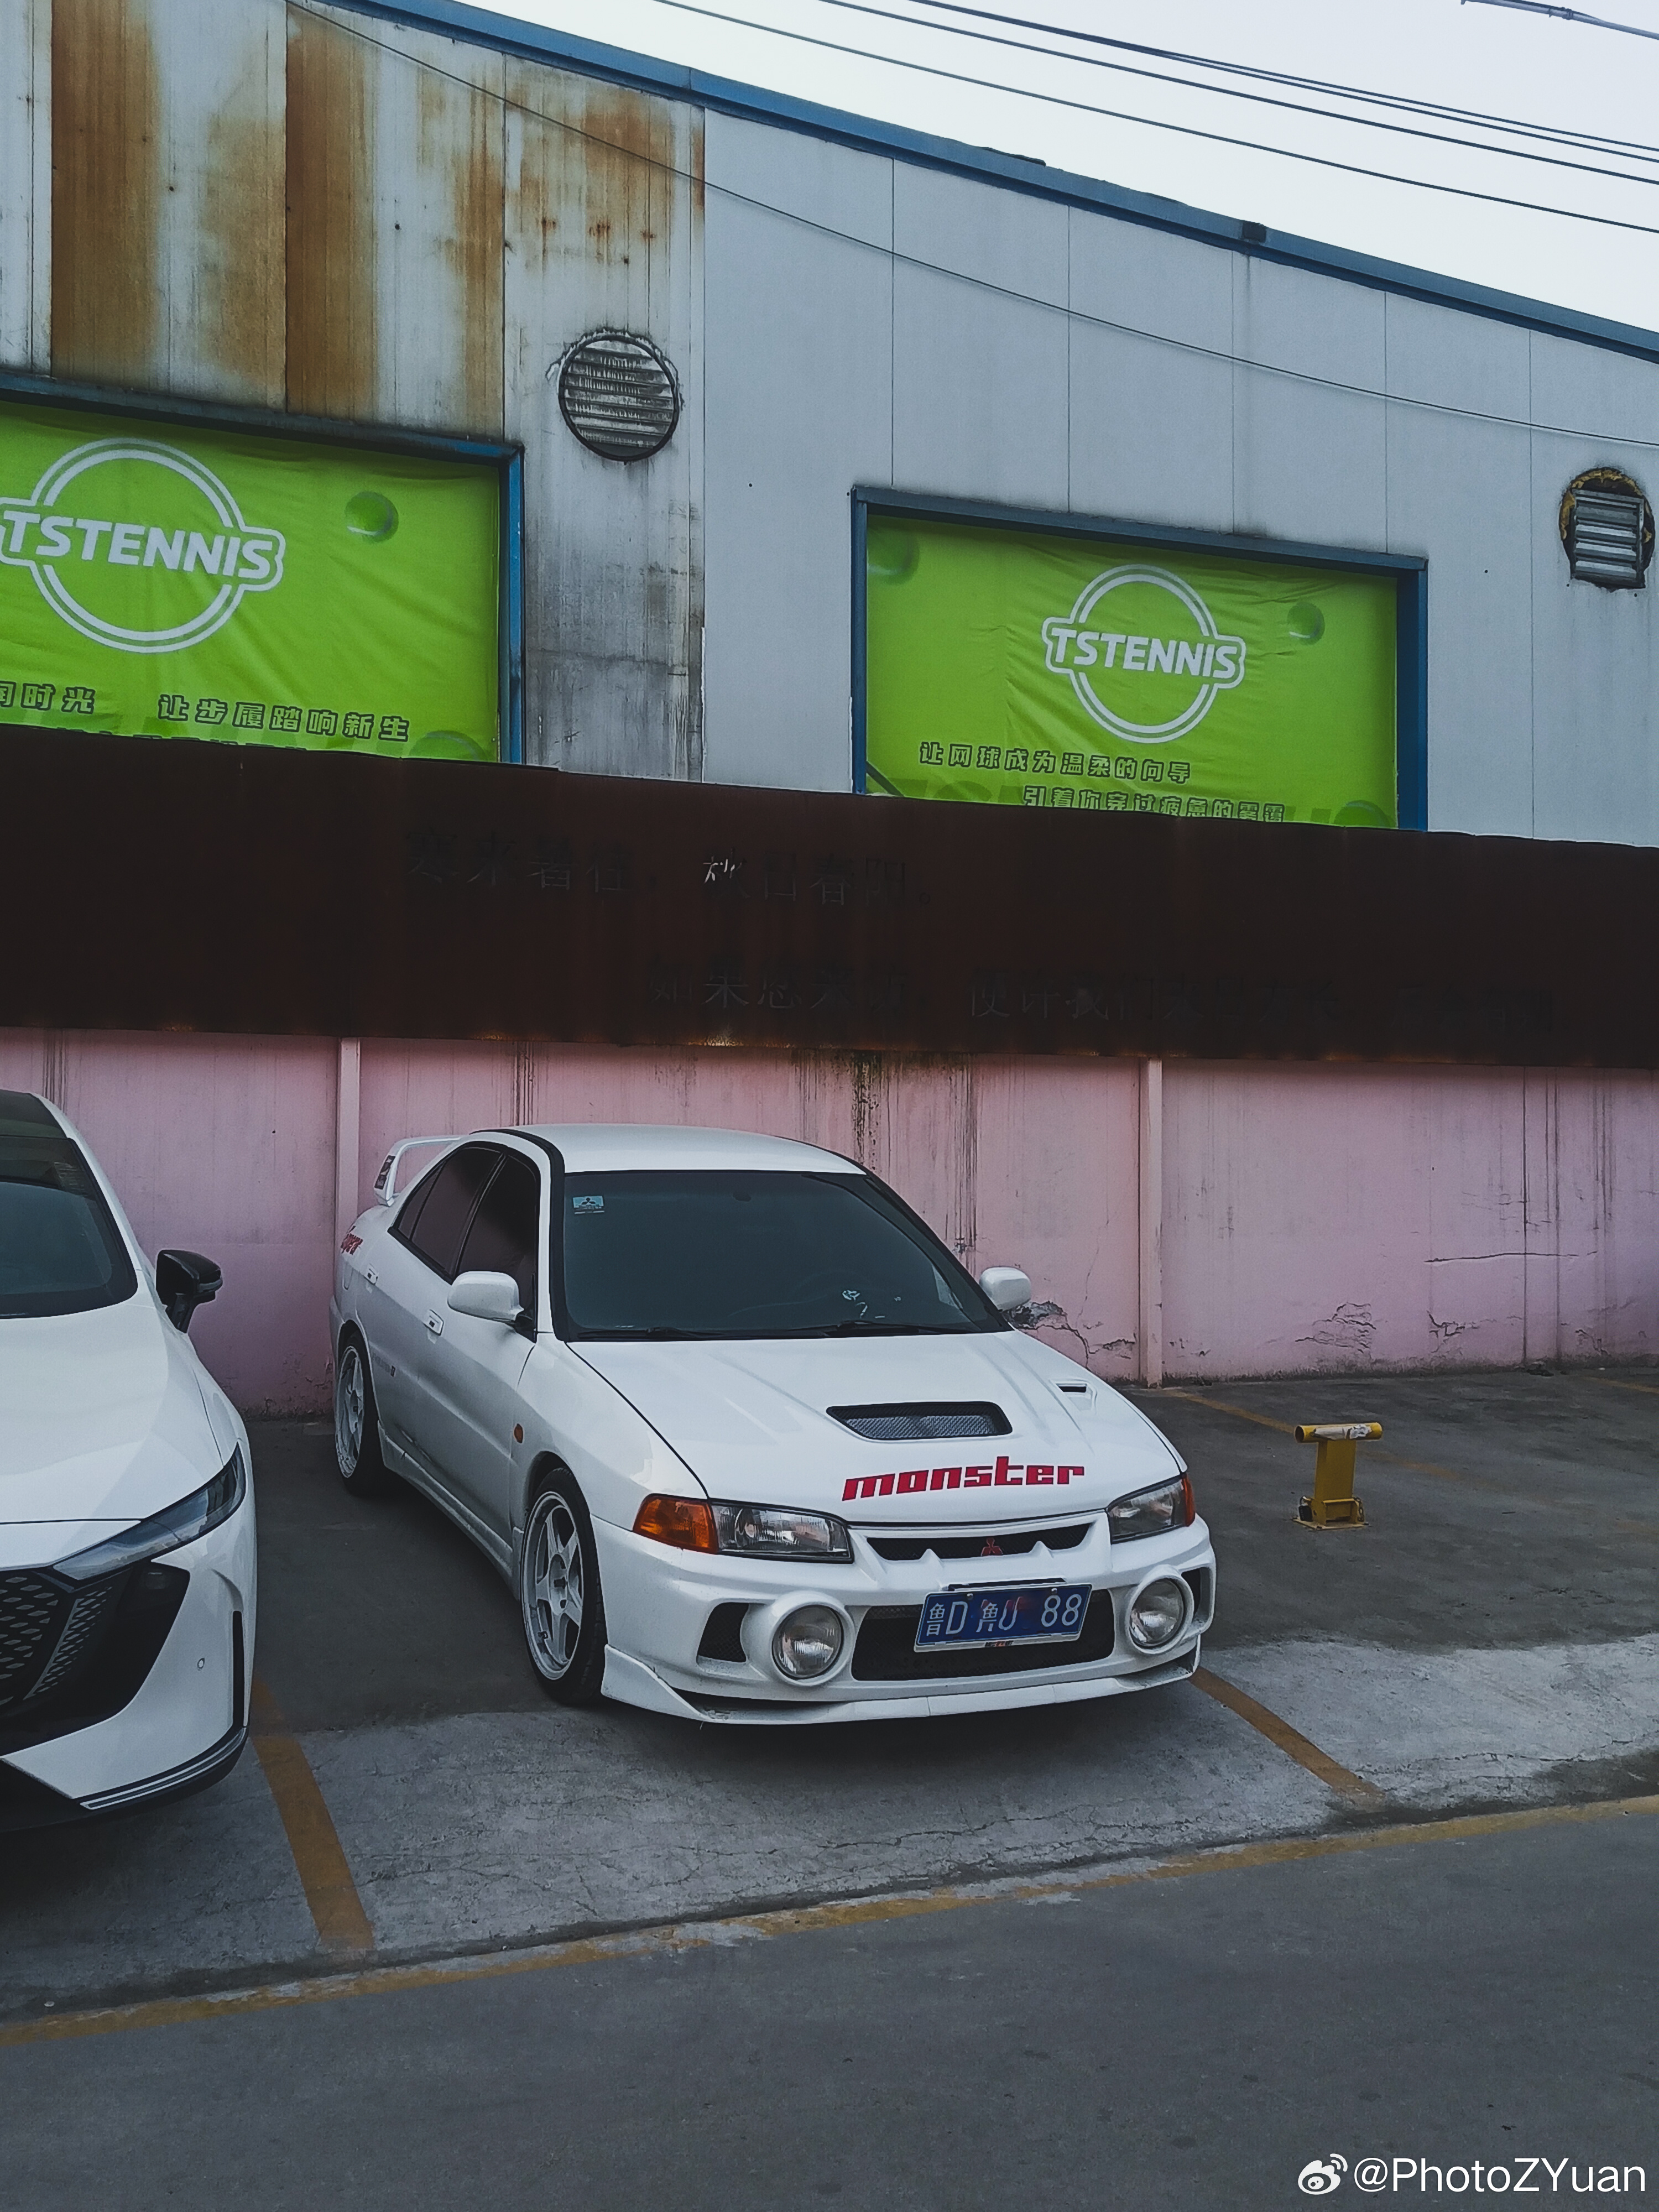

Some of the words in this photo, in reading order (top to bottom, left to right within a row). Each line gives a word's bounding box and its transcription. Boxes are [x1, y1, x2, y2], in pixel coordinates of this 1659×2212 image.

[3, 510, 273, 580] TSTENNIS
[1051, 627, 1238, 679] TSTENNIS
[158, 695, 410, 742] 让步履踏响新生
[919, 742, 1192, 784] 让网球成为温柔的向导
[842, 1455, 1085, 1501] monster
